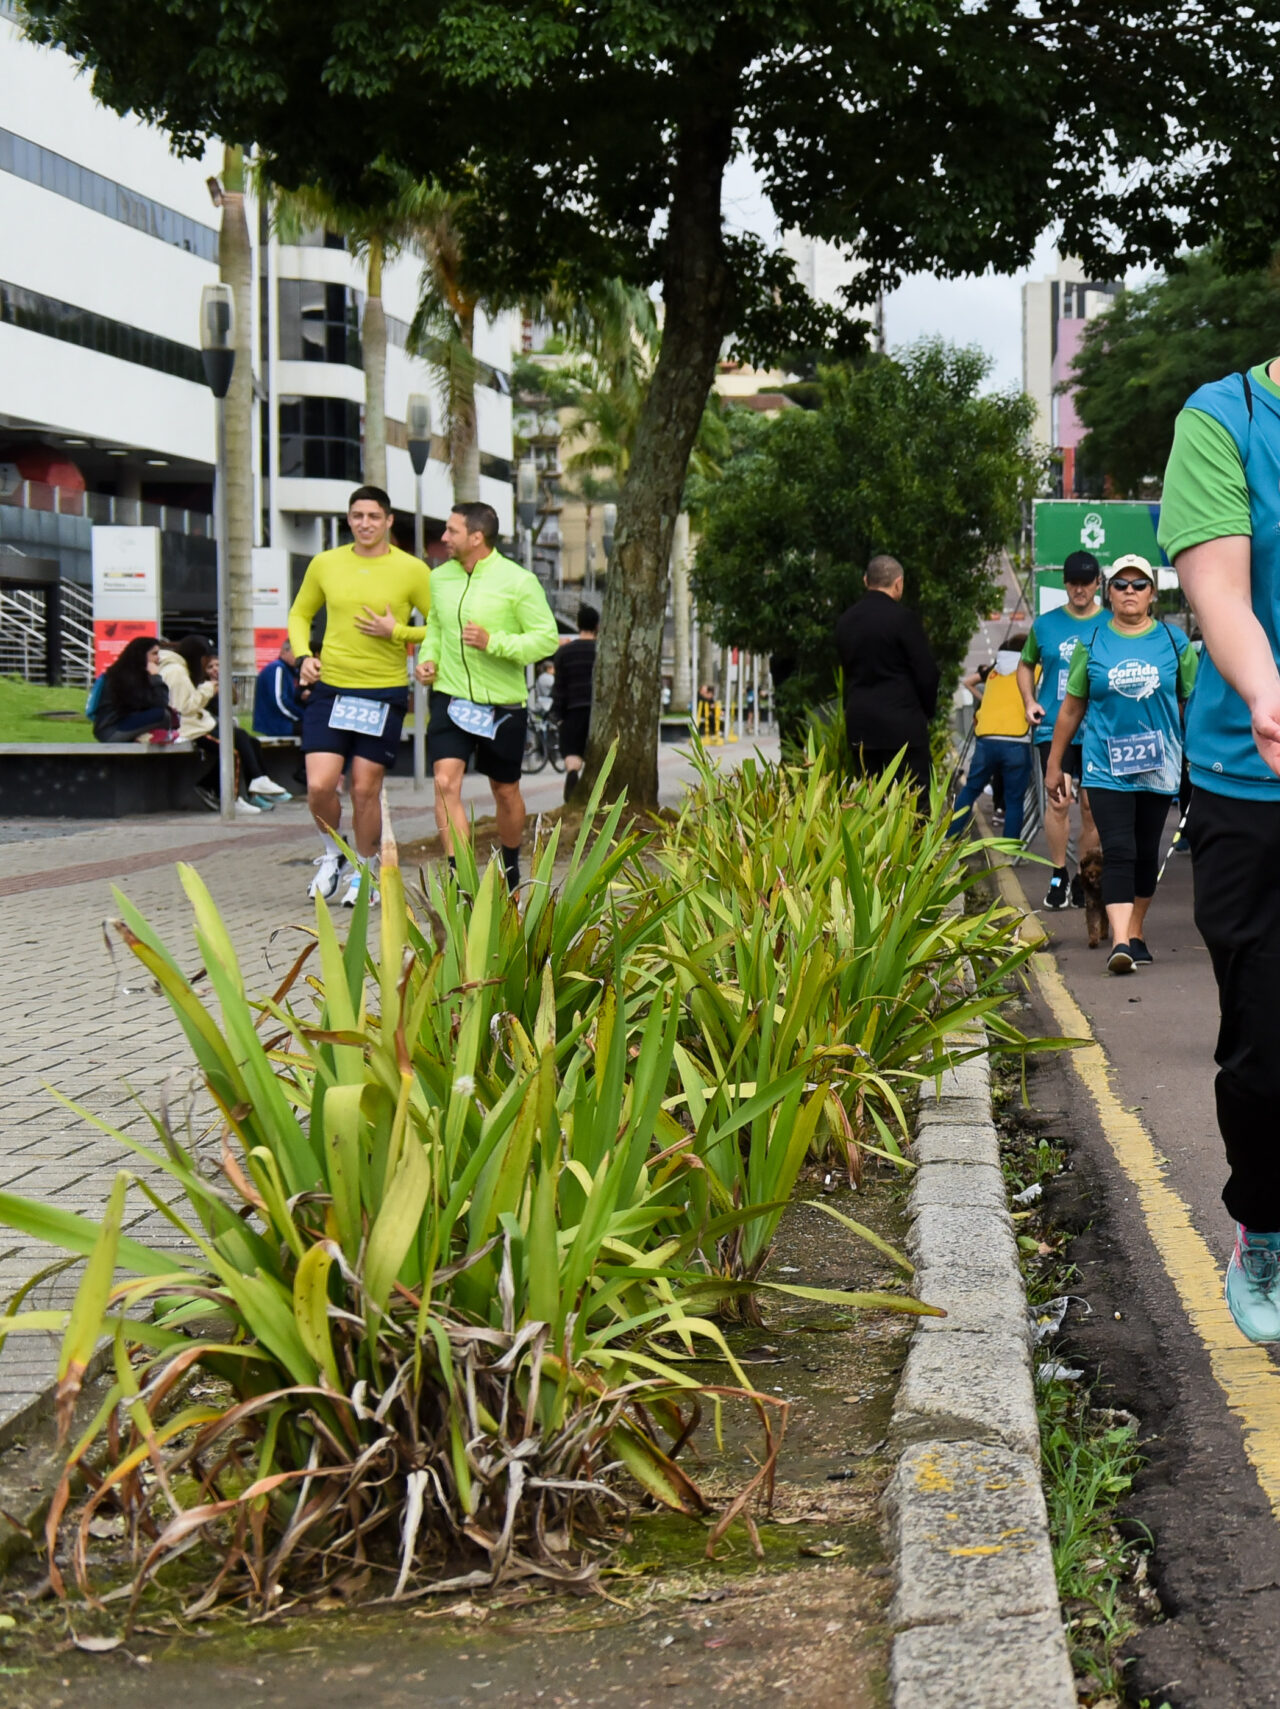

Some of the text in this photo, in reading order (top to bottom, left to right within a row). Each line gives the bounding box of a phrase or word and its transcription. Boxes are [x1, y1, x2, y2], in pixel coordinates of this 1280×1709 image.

[1108, 664, 1158, 679] Corrida
[334, 704, 380, 725] 5228
[1111, 743, 1156, 763] 3221
